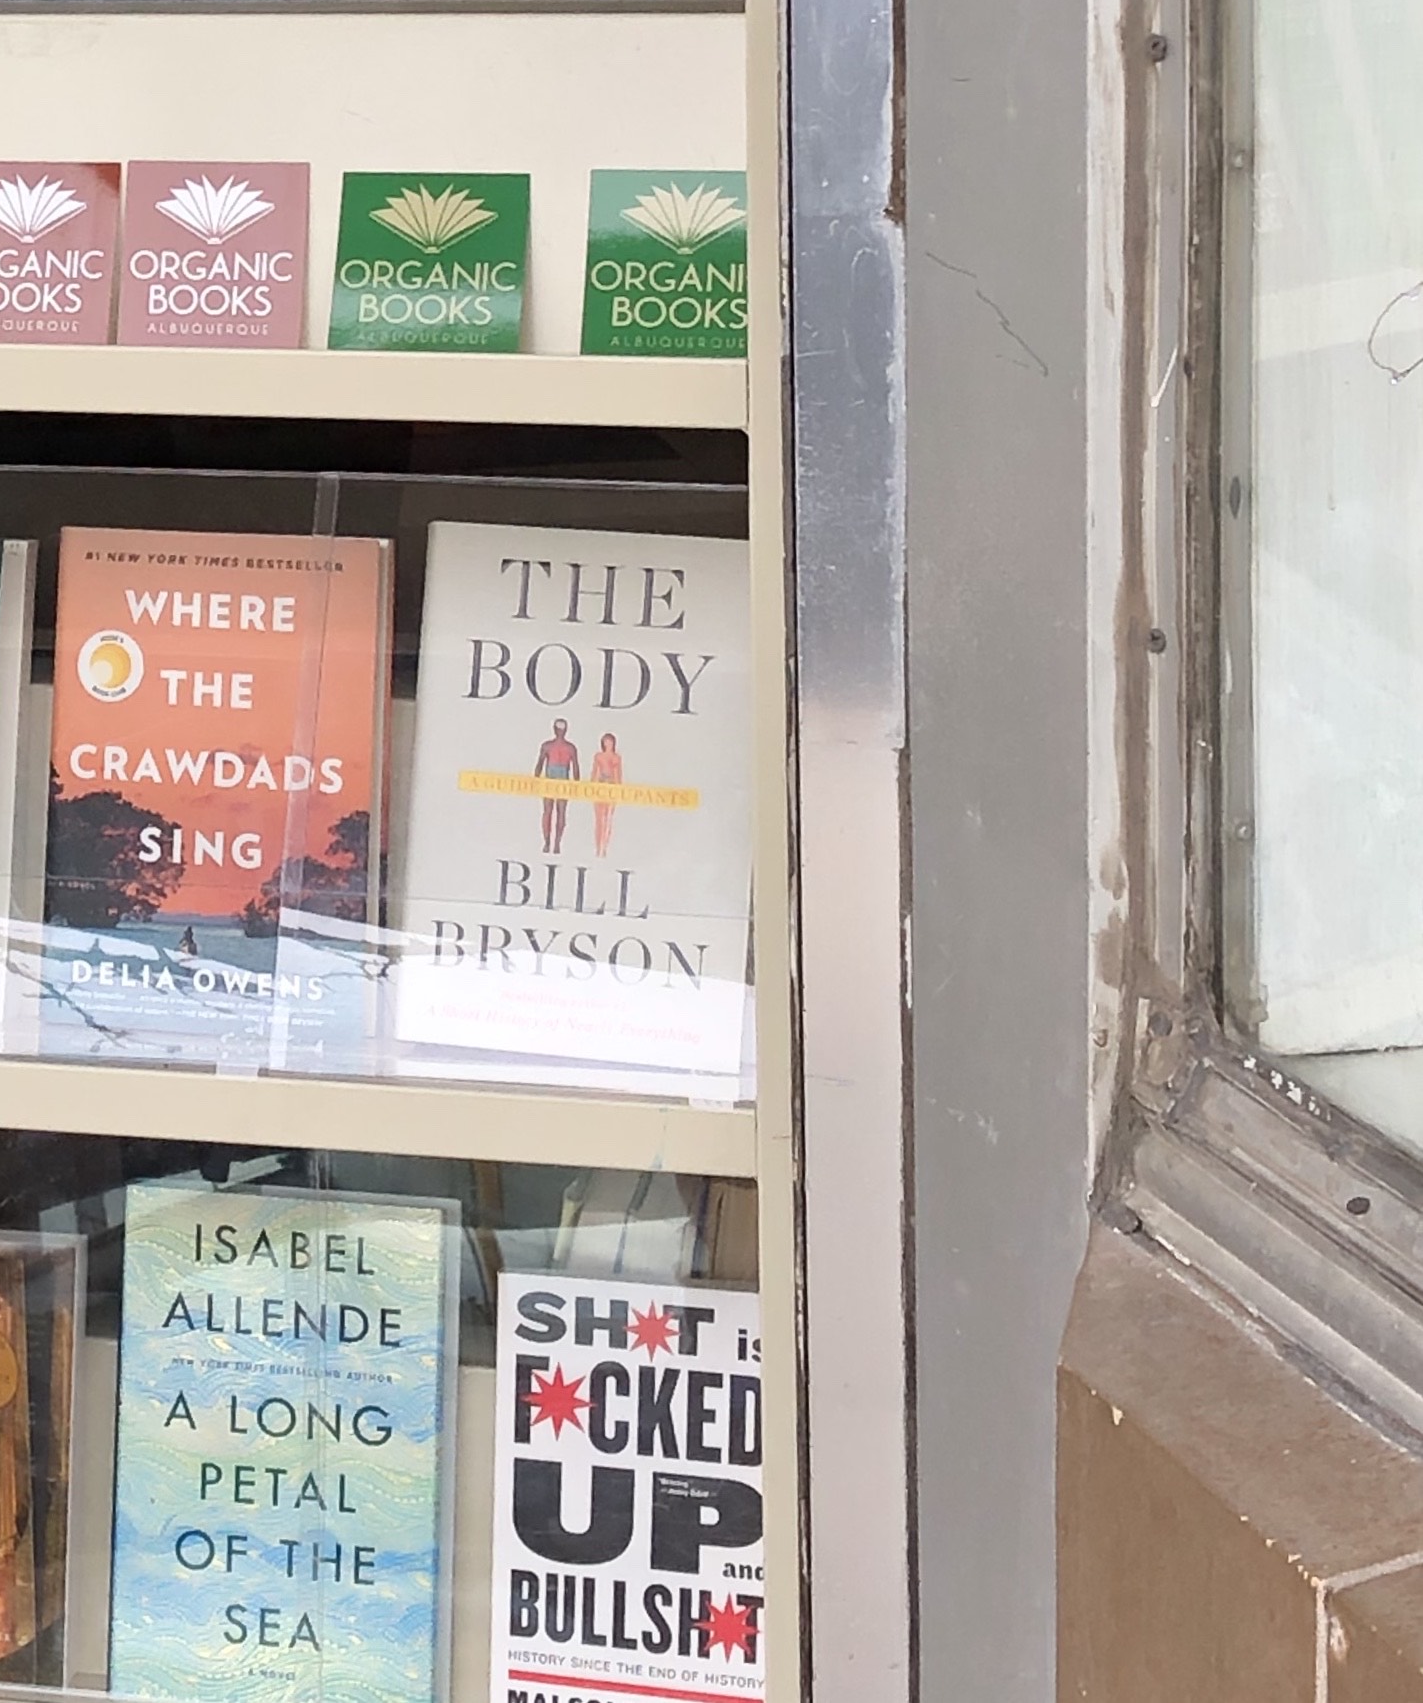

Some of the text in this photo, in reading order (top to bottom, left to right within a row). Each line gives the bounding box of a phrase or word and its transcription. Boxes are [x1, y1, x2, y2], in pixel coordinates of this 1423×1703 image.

[129, 250, 293, 282] ORGANIC
[339, 259, 516, 292] ORGANIC
[590, 259, 745, 293] ORGANI
[148, 285, 272, 316] BOOKS
[358, 294, 493, 325] BOOKS
[611, 296, 748, 330] BOOKS
[147, 322, 269, 336] ALBUQUERQUE
[610, 335, 747, 350] ALBUQUERQUE
[107, 552, 140, 563] NEW
[147, 554, 186, 565] YORK
[194, 556, 239, 568] TIMES
[246, 558, 344, 572] BESTSELLER
[125, 589, 296, 632] WHERE
[501, 558, 688, 630] THE
[160, 669, 255, 709] THE
[461, 638, 715, 715] BODY
[70, 743, 344, 794] CRAWDADS
[470, 777, 691, 806] A GUIDE FOR OCCUPANTS
[138, 825, 263, 869] SING
[495, 859, 650, 920] BILL
[430, 919, 711, 992] BRYSON
[72, 959, 175, 990] DELIA
[193, 967, 325, 1002] OWENS
[194, 1223, 375, 1276] ISABEL
[161, 1291, 402, 1348] ALLENDE
[738, 1328, 762, 1363] is
[200, 1359, 228, 1370] YORK
[235, 1361, 265, 1373] TIMES
[270, 1364, 341, 1379] BESTSELLING
[347, 1369, 393, 1384] AUTHOR
[164, 1390, 393, 1447] A LONG
[200, 1462, 357, 1514] PETAL
[512, 1456, 764, 1575] UP
[175, 1529, 376, 1586] OF THE
[224, 1603, 321, 1652] SEA
[508, 1649, 765, 1689] HISTORY SINCE THE END OF HISTORY
